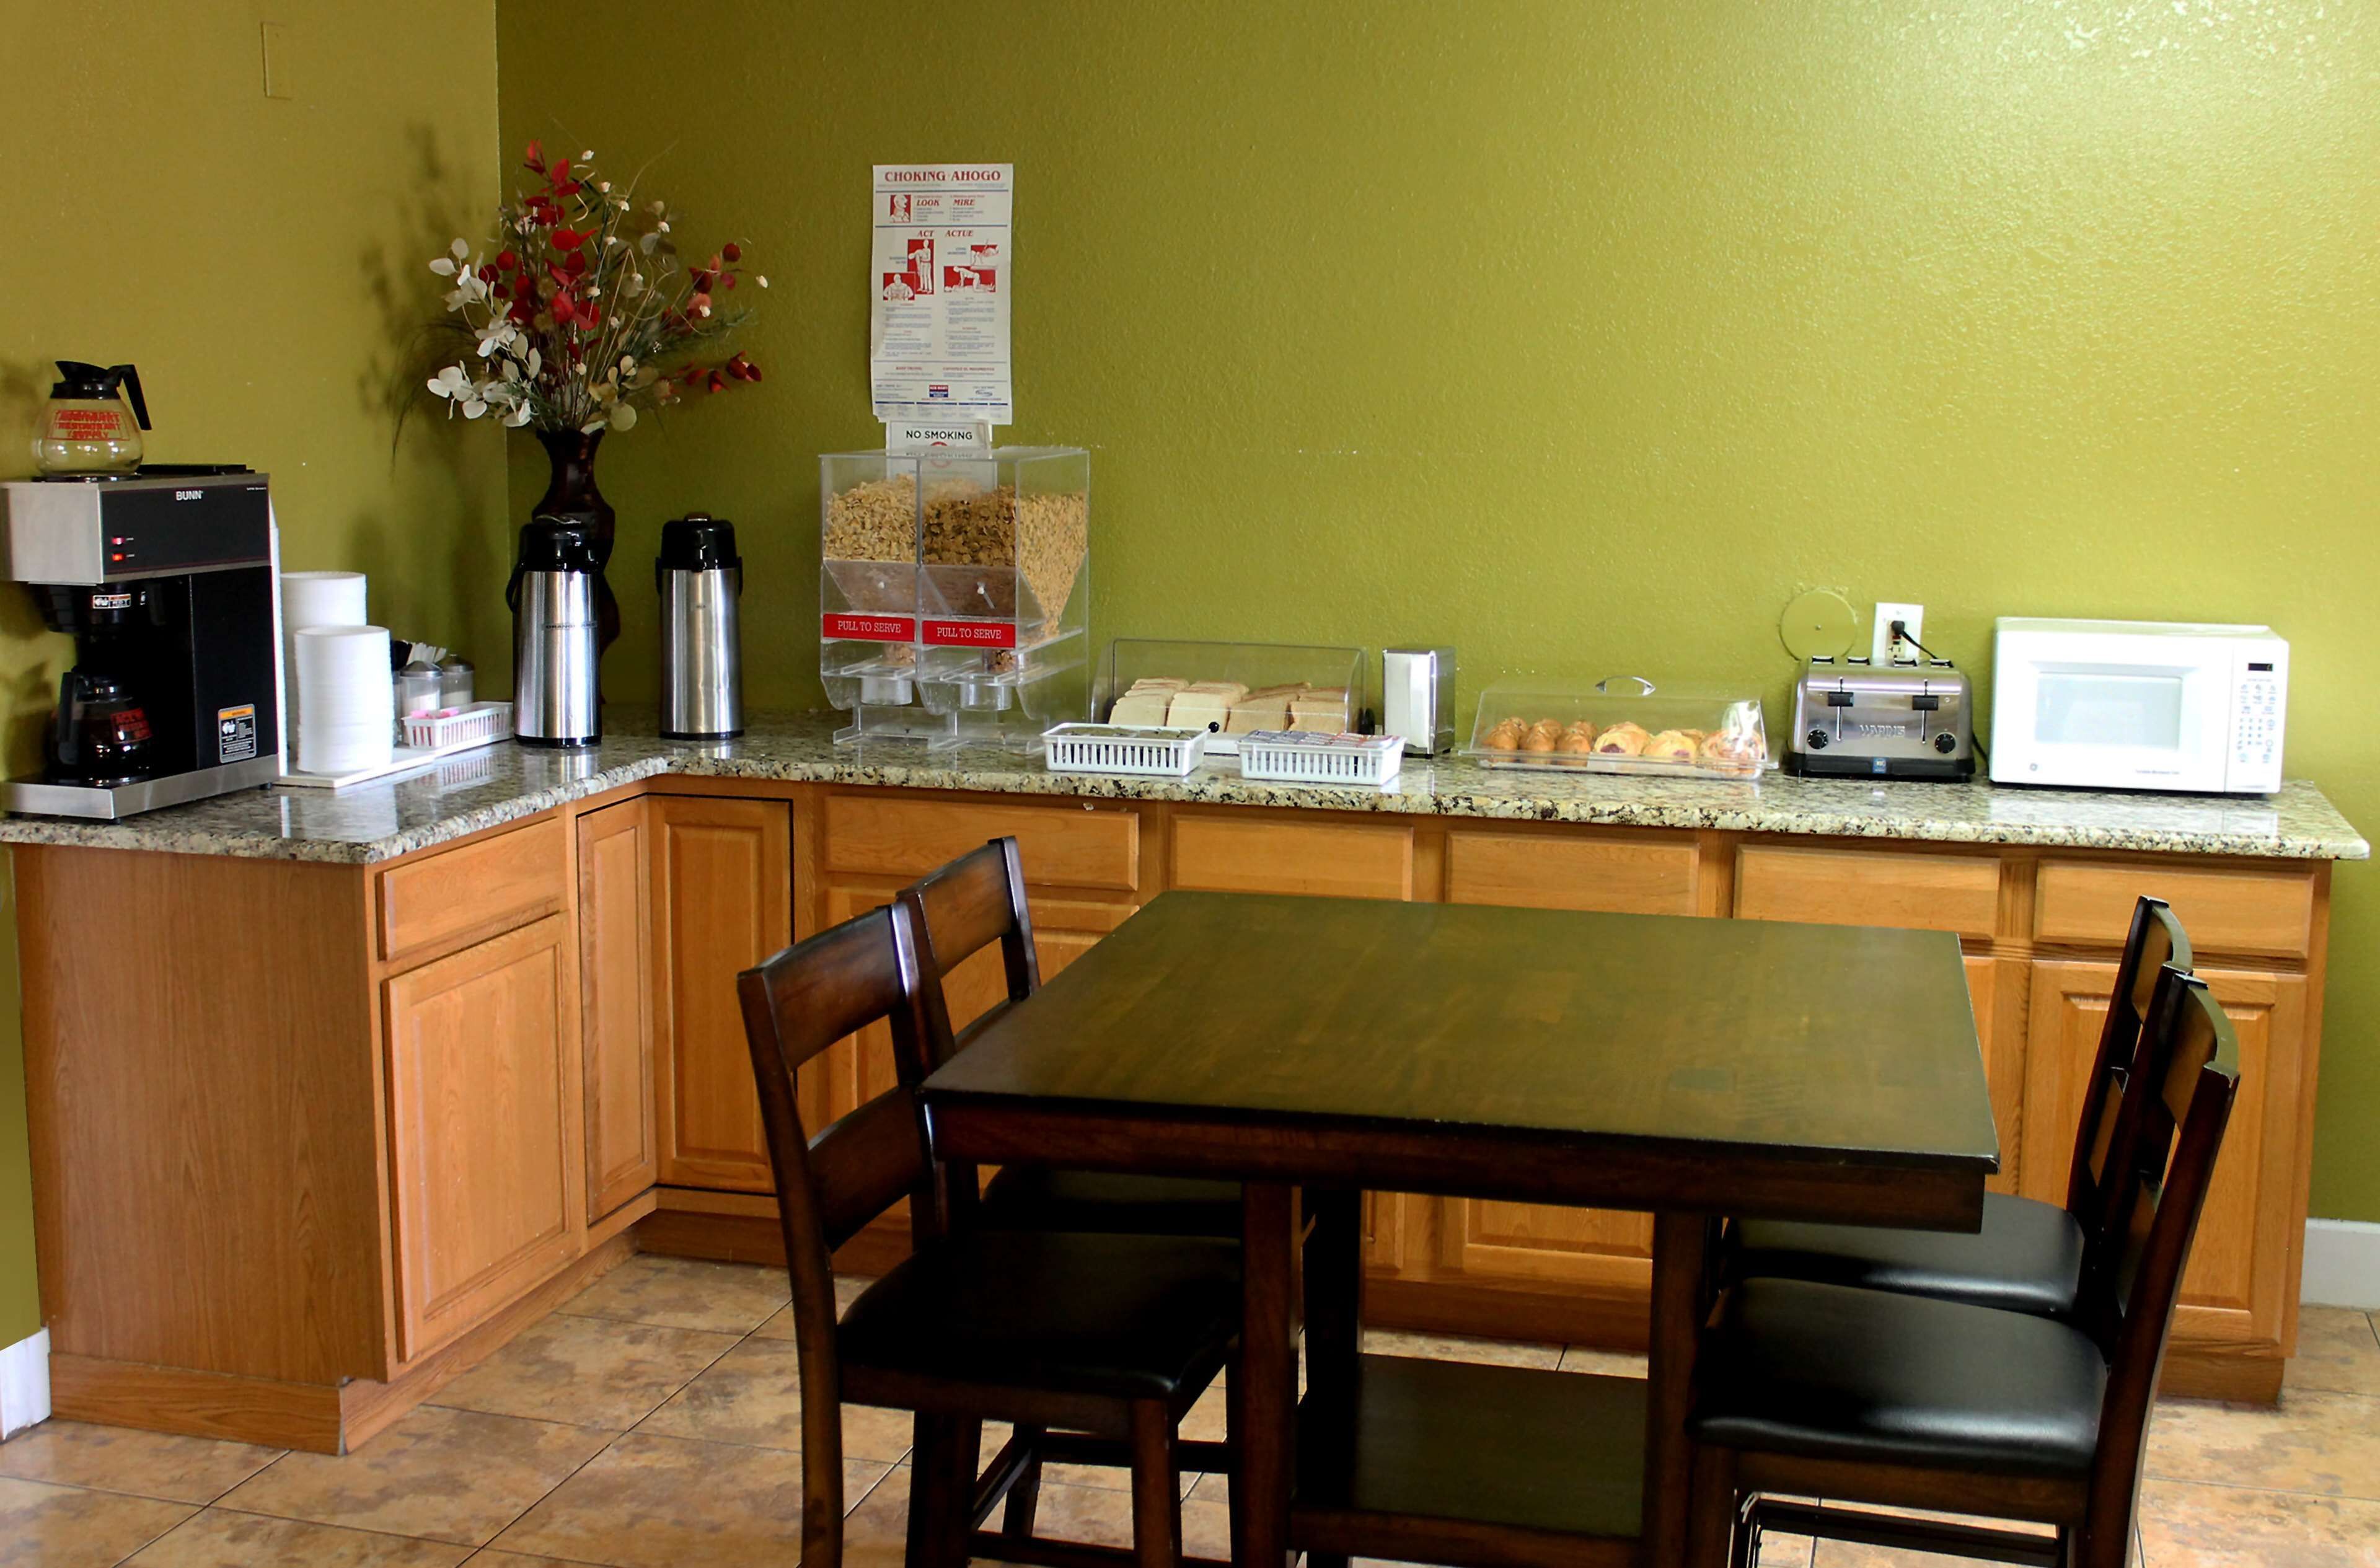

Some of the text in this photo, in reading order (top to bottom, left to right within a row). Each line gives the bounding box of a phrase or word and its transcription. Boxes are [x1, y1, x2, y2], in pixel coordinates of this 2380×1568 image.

[884, 170, 1001, 182] CHOKING AHOGO
[906, 430, 972, 440] NO SMOKING
[176, 490, 202, 501] BUNN
[838, 620, 901, 633] PULL TO SERVE
[937, 627, 1002, 639] PULL TO SERVE
